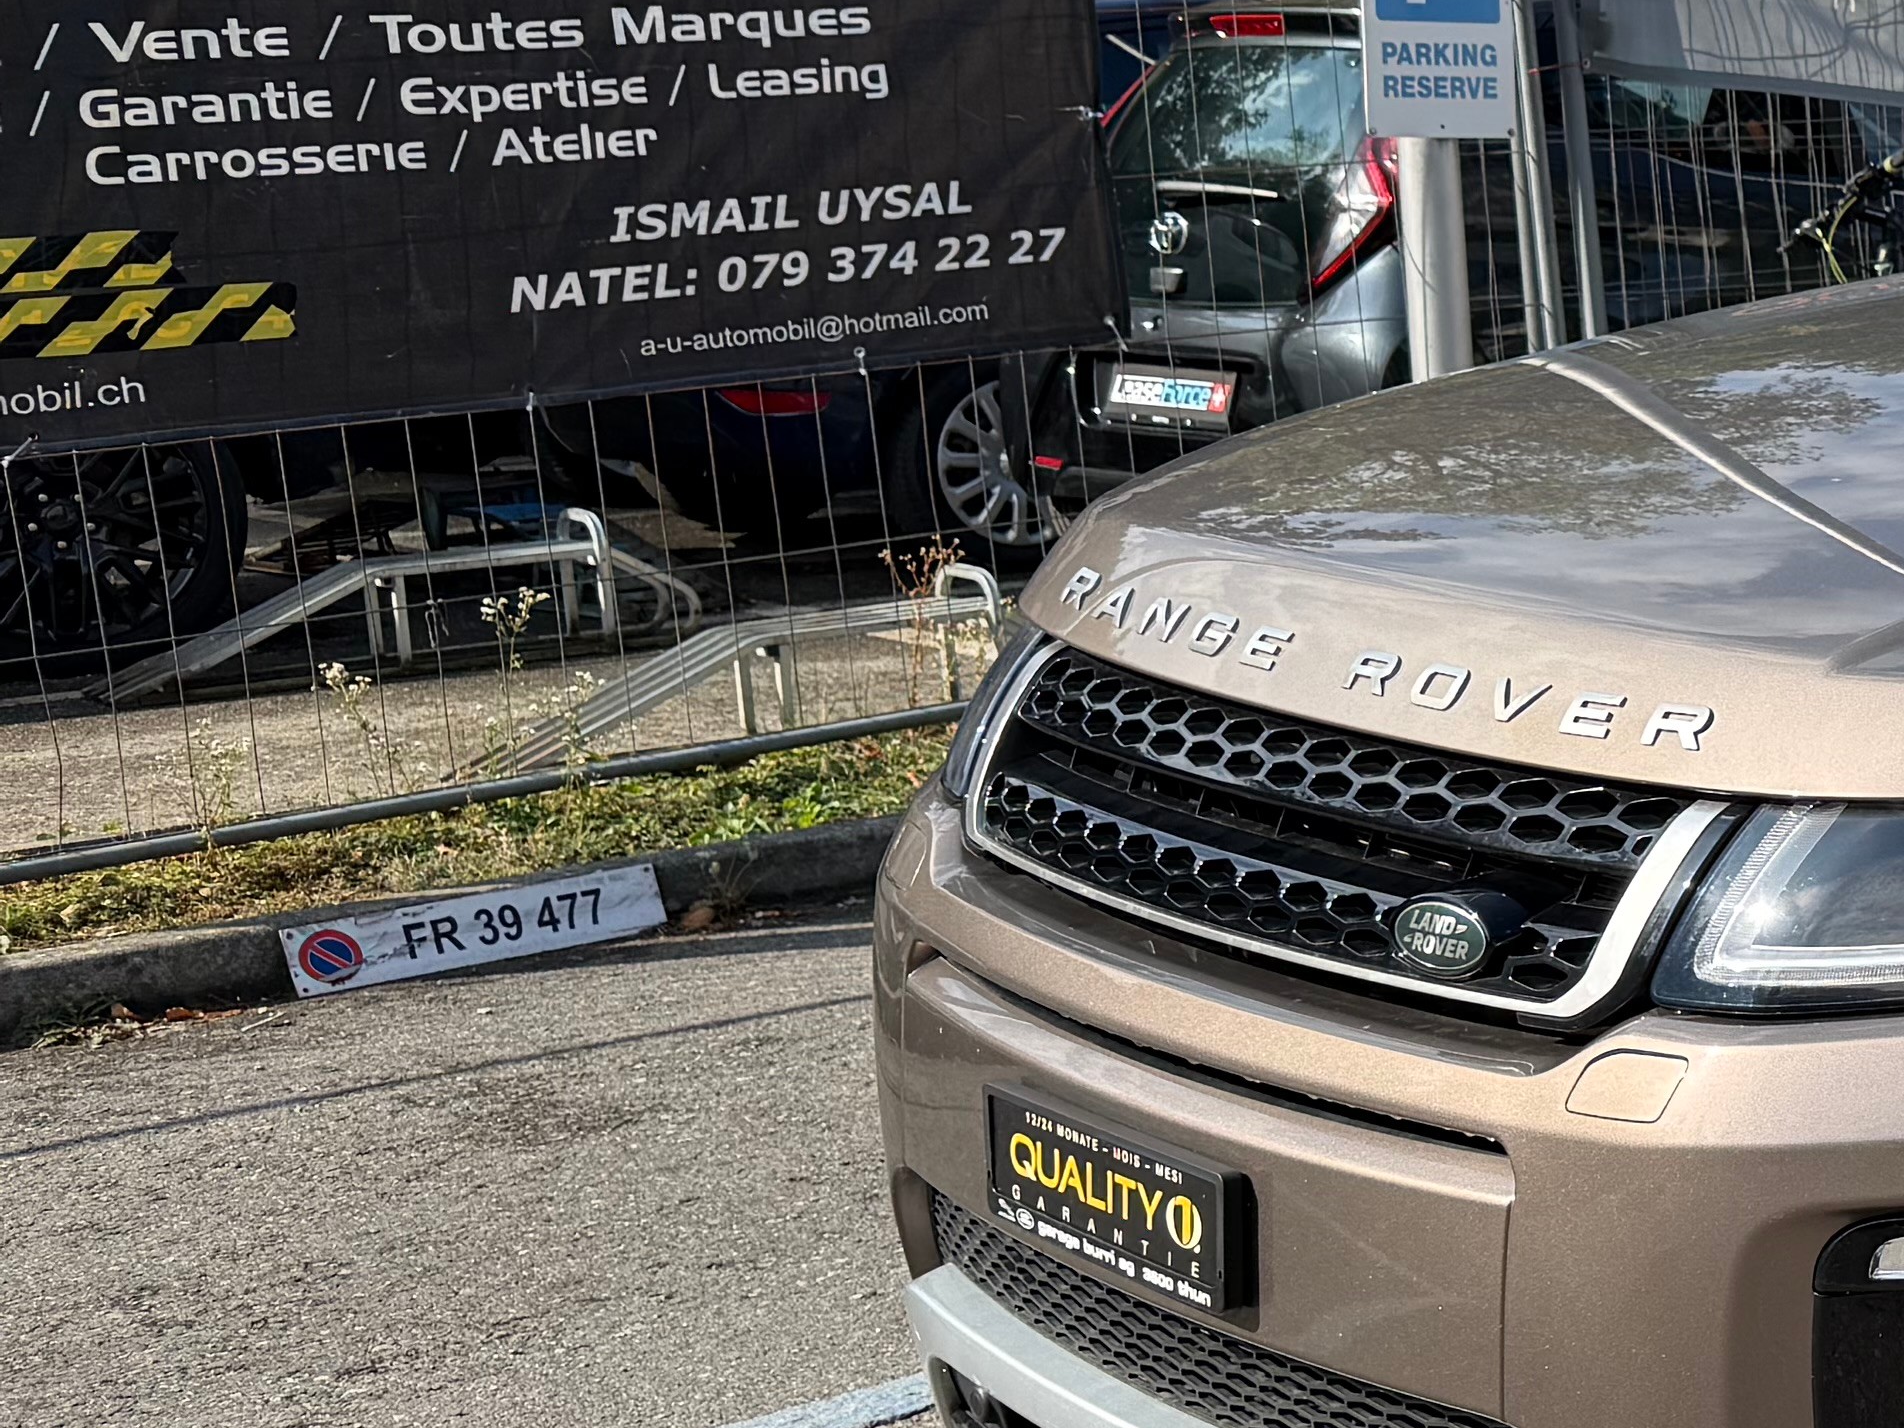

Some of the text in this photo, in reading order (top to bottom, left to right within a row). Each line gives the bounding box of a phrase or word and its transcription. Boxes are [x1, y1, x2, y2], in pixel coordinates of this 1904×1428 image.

[88, 18, 290, 64] Vente
[368, 12, 585, 54] Toutes
[611, 5, 871, 48] Marques
[1381, 41, 1497, 68] PARKING
[79, 81, 333, 128] Garantie
[400, 69, 649, 123] Expertise
[708, 58, 888, 100] Leasing
[1383, 75, 1498, 100] RESERVE
[609, 180, 973, 243] ISMAIL UYSAL
[510, 227, 1067, 314] NATEL: 079 374 22 27
[639, 302, 990, 357] a-u-automobil@hotmail.com
[1059, 566, 1716, 753] RANGE ROVER
[402, 887, 602, 961] FR 39 477
[1409, 908, 1457, 937] LAND
[1410, 930, 1470, 961] ROVER
[1025, 1110, 1053, 1133] 12/24
[1055, 1122, 1099, 1153] MONATE
[1112, 1146, 1142, 1169] MOIS
[1154, 1162, 1184, 1185] MESI
[1011, 1184, 1201, 1279] GARANTIE
